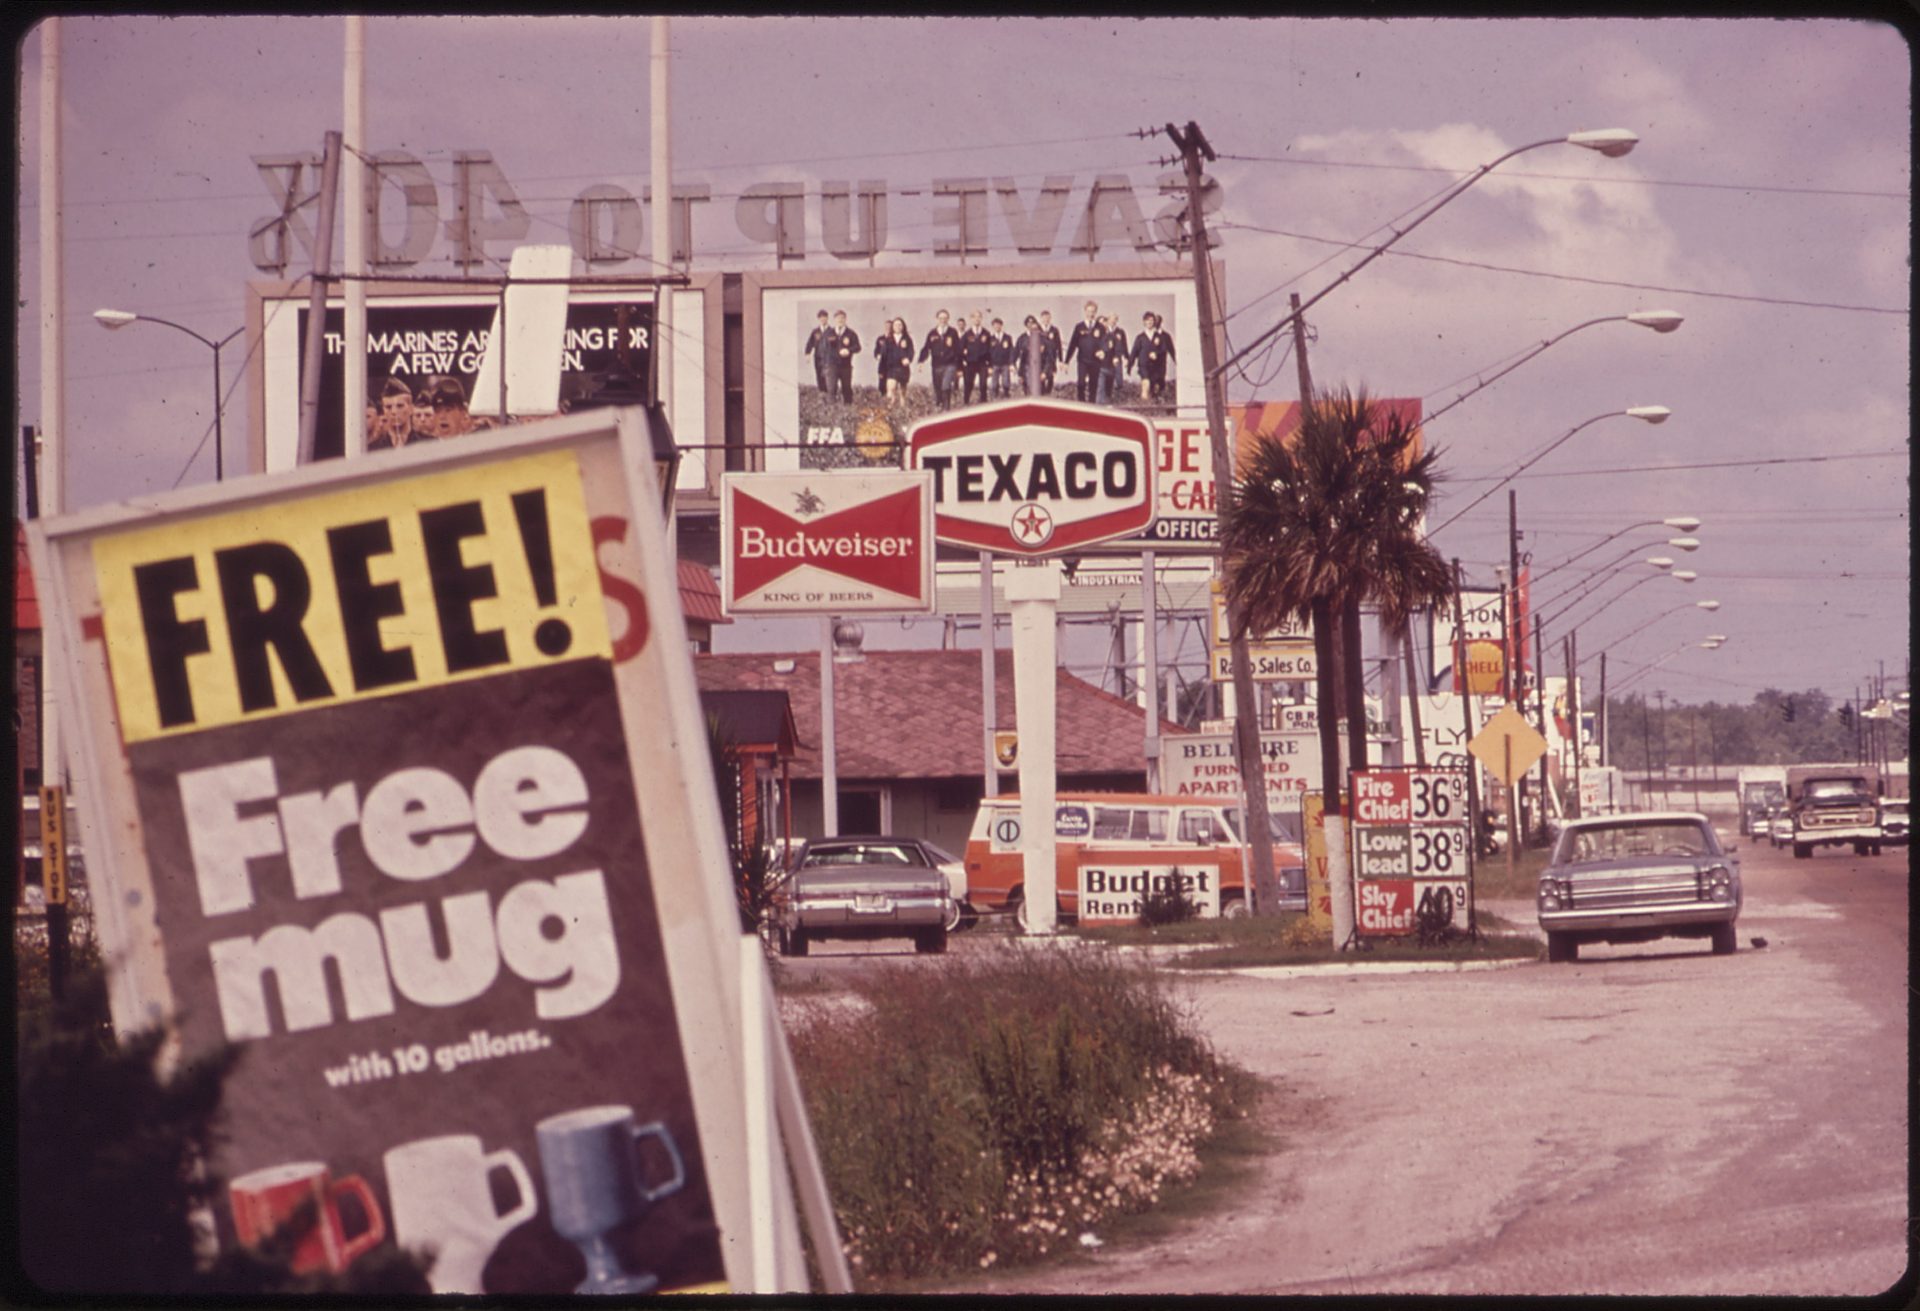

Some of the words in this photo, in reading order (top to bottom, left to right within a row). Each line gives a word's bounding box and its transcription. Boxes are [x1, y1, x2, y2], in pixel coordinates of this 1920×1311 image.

[367, 331, 458, 353] MARINES
[461, 330, 489, 353] AR
[390, 353, 410, 375] A
[412, 352, 455, 374] FEW
[806, 426, 845, 445] FFA
[921, 450, 1137, 503] TEXACO
[738, 525, 914, 559] Budweiser
[1077, 574, 1143, 587] INDUSTRIAL
[133, 486, 573, 729] FREE!
[763, 592, 801, 602] KING
[805, 592, 824, 602] OF
[829, 591, 874, 602] BEERS
[1220, 656, 1256, 676] Rao
[1258, 656, 1293, 675] Sales
[1296, 656, 1315, 674] Co.
[1466, 660, 1501, 674] HELL
[1356, 777, 1394, 797] Fire
[1358, 799, 1410, 820] Chief
[177, 745, 589, 917] Free
[1360, 831, 1409, 851] Low-
[1361, 853, 1409, 875] lead
[1086, 869, 1210, 899] Budget
[1361, 884, 1398, 910] Sky
[1361, 909, 1412, 930] Chief
[208, 868, 623, 1041] mug
[323, 1051, 393, 1088] with
[393, 1043, 430, 1075] 10
[434, 1028, 552, 1073] gallons.
